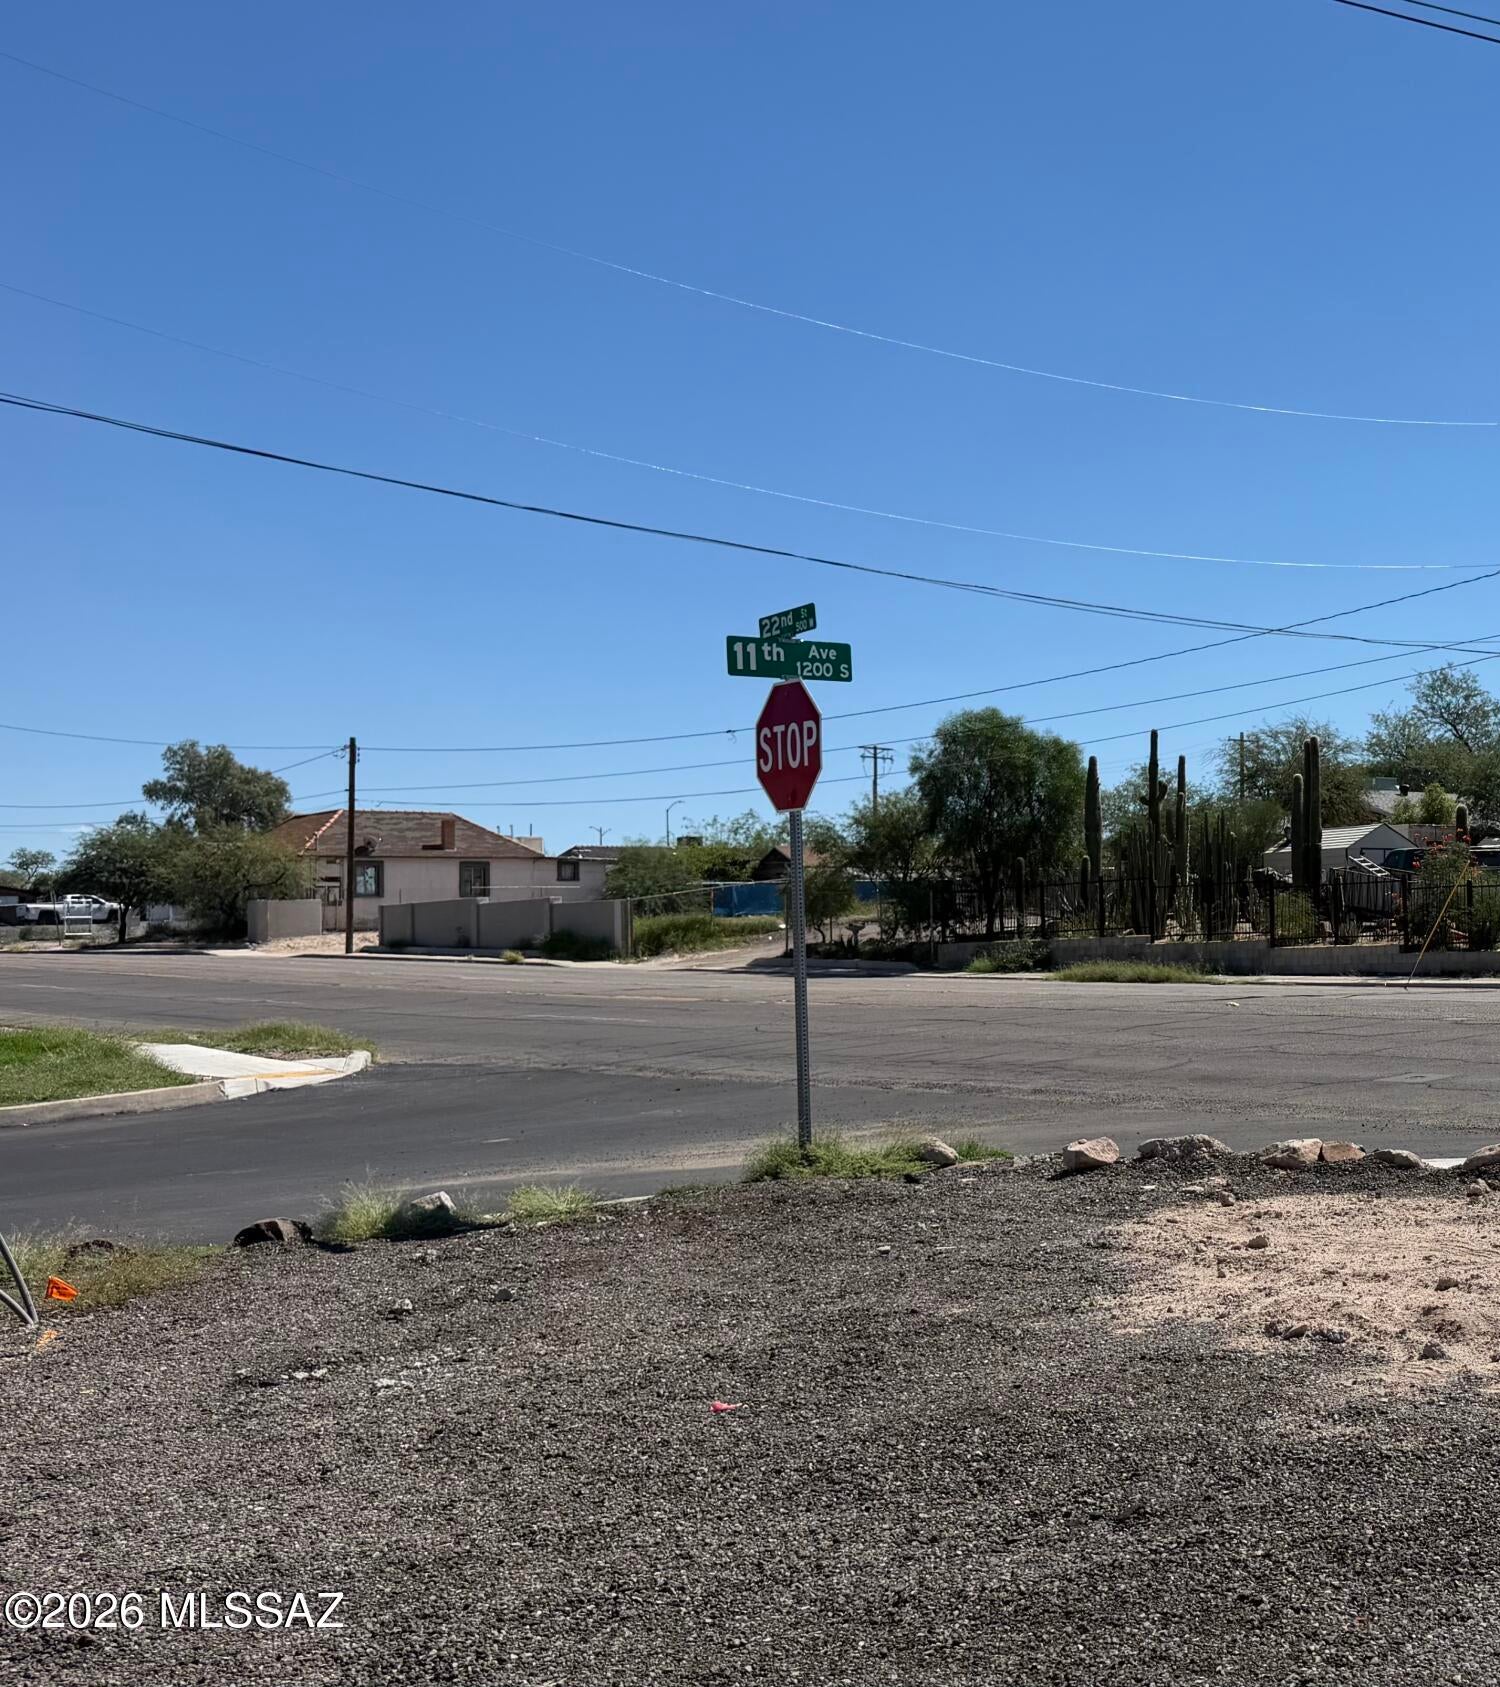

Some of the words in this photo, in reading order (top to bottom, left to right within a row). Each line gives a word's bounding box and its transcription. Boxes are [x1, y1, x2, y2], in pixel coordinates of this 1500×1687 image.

[762, 611, 793, 638] 22nd
[733, 641, 785, 671] 11th
[808, 644, 837, 660] Ave
[796, 661, 833, 677] 1200
[840, 664, 849, 678] S
[759, 720, 818, 773] STOP
